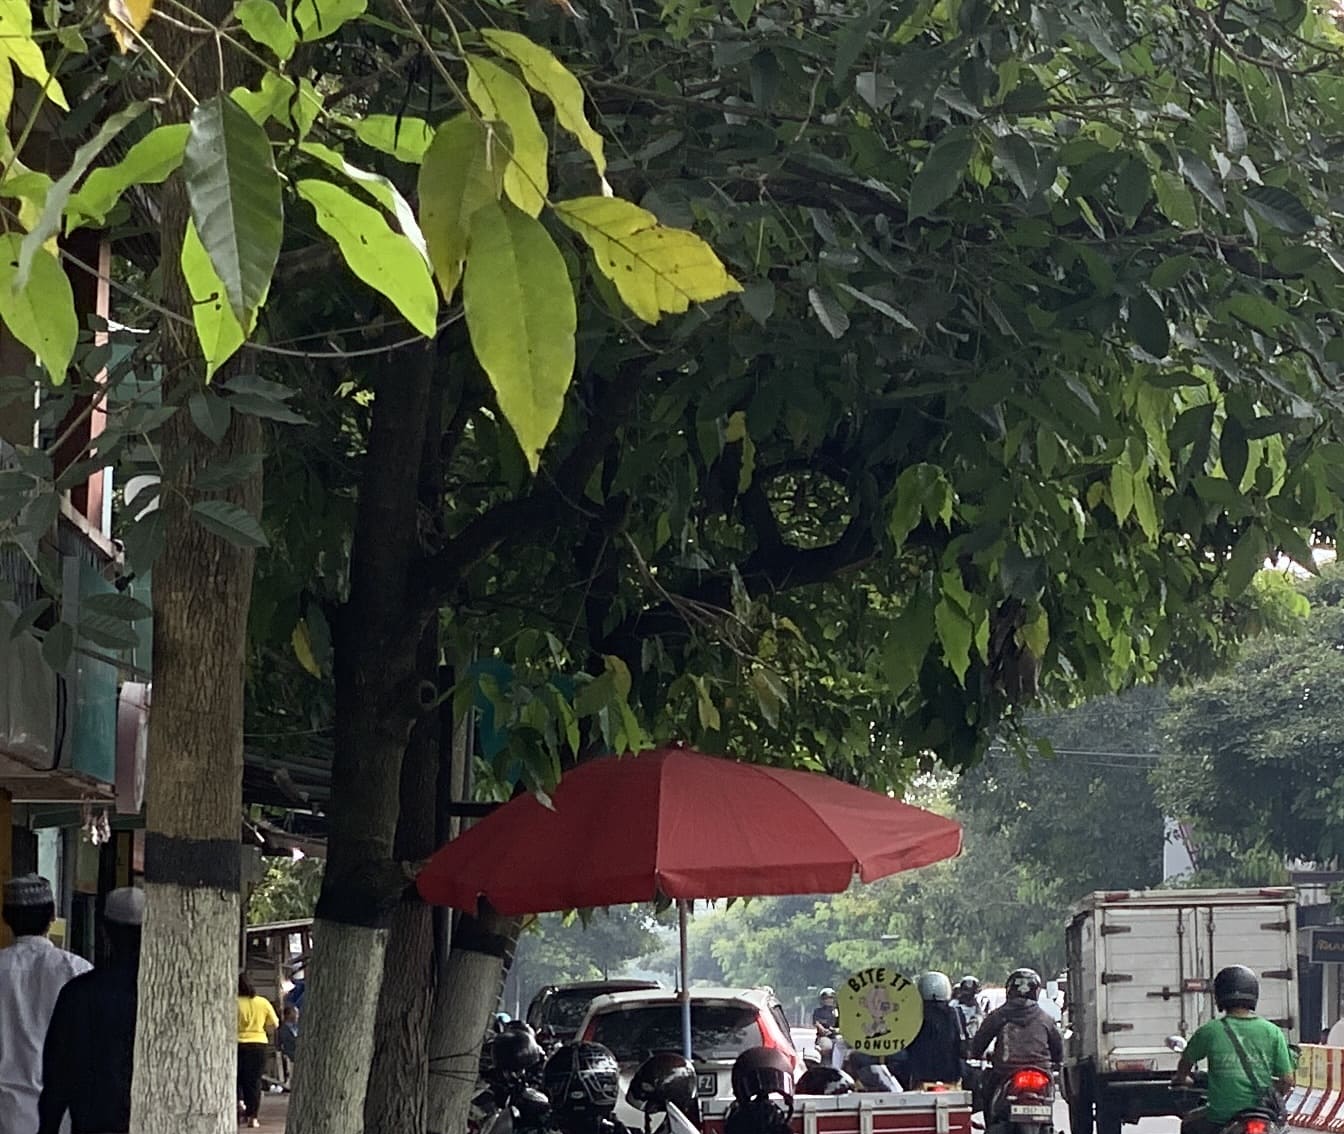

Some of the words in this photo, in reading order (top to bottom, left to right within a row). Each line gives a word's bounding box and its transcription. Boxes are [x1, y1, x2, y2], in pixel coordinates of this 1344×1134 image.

[848, 967, 886, 993] BITE
[890, 974, 911, 992] IT
[855, 1039, 905, 1050] DONUTS
